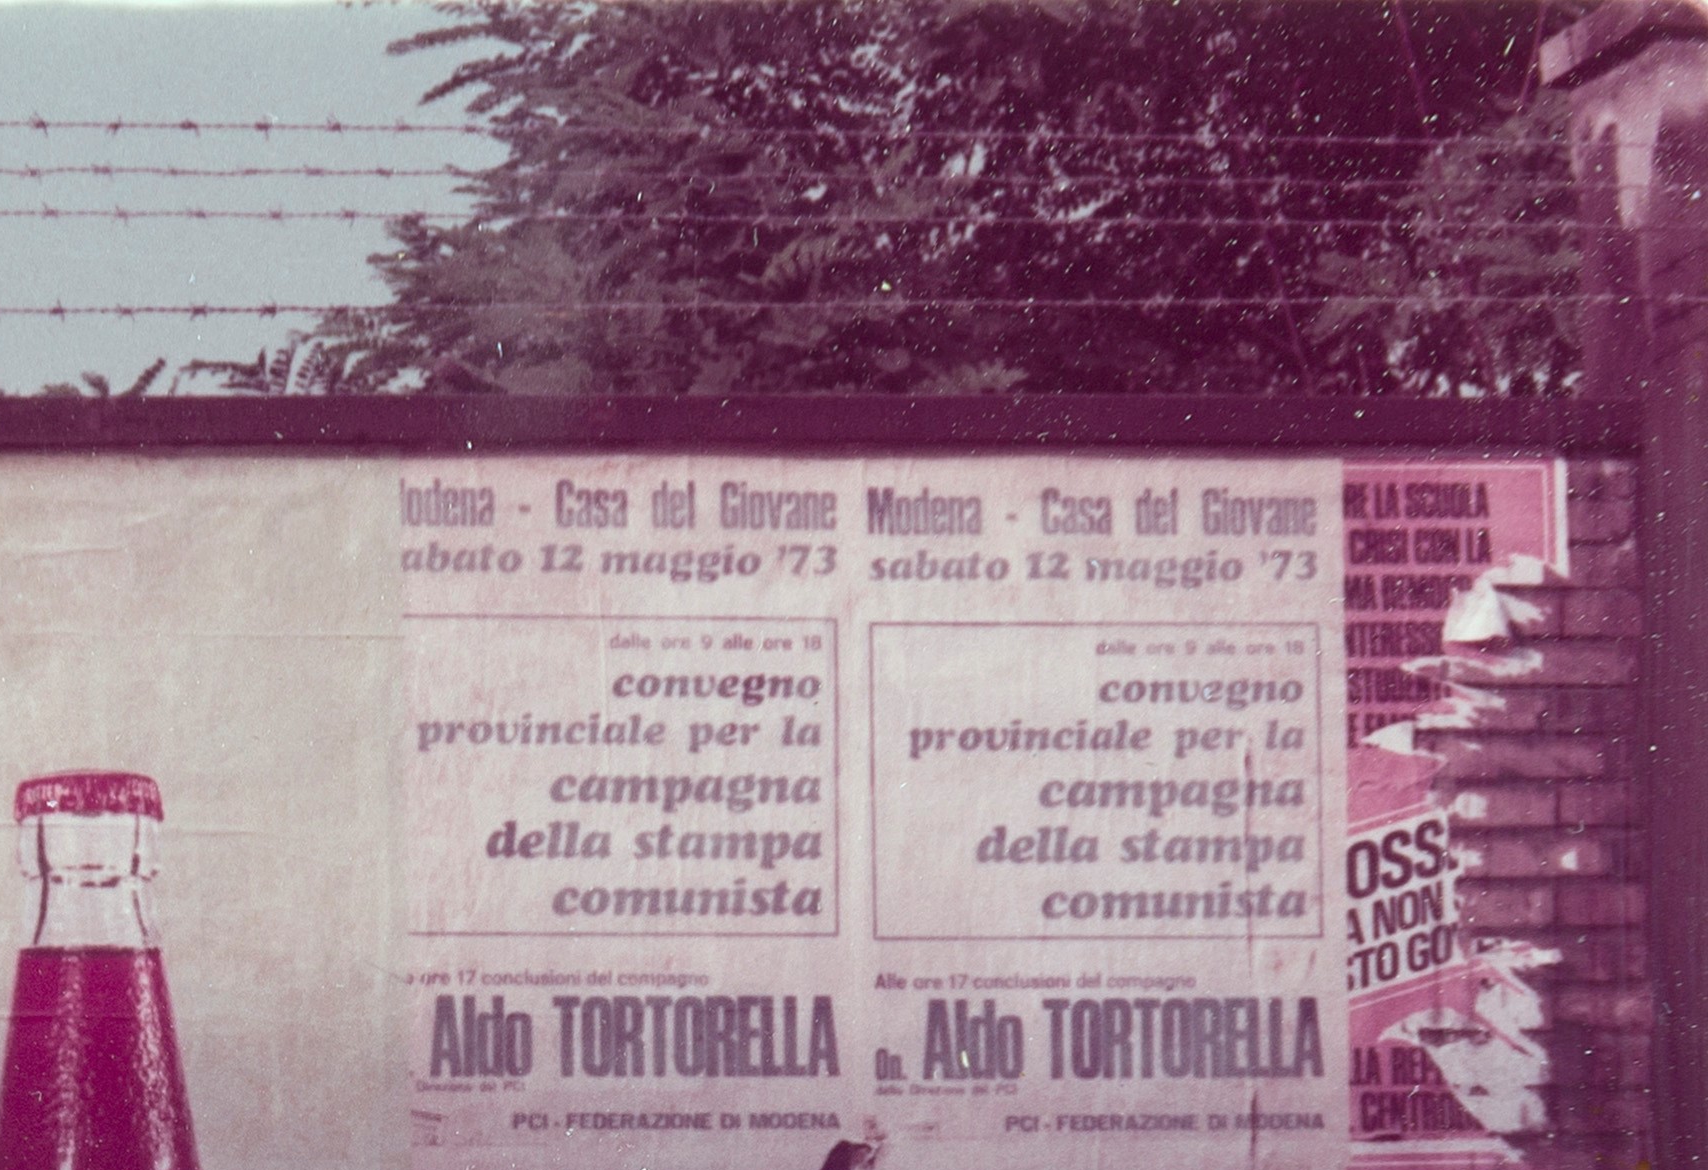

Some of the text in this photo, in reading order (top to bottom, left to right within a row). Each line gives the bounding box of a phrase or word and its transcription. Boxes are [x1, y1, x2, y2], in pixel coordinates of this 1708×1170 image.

[555, 479, 628, 529] Casa
[652, 480, 696, 529] del
[720, 481, 838, 530] Giovane
[867, 486, 1318, 537] Modena Casa del Giovane
[540, 544, 584, 573] 12
[600, 545, 762, 582] maggio
[869, 550, 1010, 582] sabato
[1025, 551, 1070, 580] 12
[1085, 550, 1244, 587] maggio
[612, 672, 822, 706] convegno
[1099, 678, 1305, 709] convegno
[418, 712, 822, 754] provinciale per la
[909, 719, 1305, 758] provinciale per la
[550, 774, 822, 813] campagna
[1039, 778, 1305, 818] campagna
[486, 821, 823, 869] della stampa
[976, 826, 1306, 872] della stampa
[552, 878, 823, 916] comunista
[1041, 881, 1307, 919] comunista
[1407, 922, 1458, 972] GO
[481, 971, 582, 986] conclusioni
[587, 970, 614, 985] del
[617, 972, 710, 989] compagno
[973, 974, 1071, 989] conclusioni
[1076, 974, 1102, 988] del
[1106, 976, 1197, 991] compagno
[429, 995, 841, 1078] Aldo TORTORELLA
[923, 999, 1024, 1080] Aldo
[1042, 997, 1325, 1079] TORTORELLA
[511, 1112, 841, 1131] PCI FEDERAZIONE DI MODENA
[1005, 1115, 1040, 1132] PCI
[1056, 1114, 1199, 1132] FEDERAZIONE
[1236, 1113, 1325, 1130] MODENA
